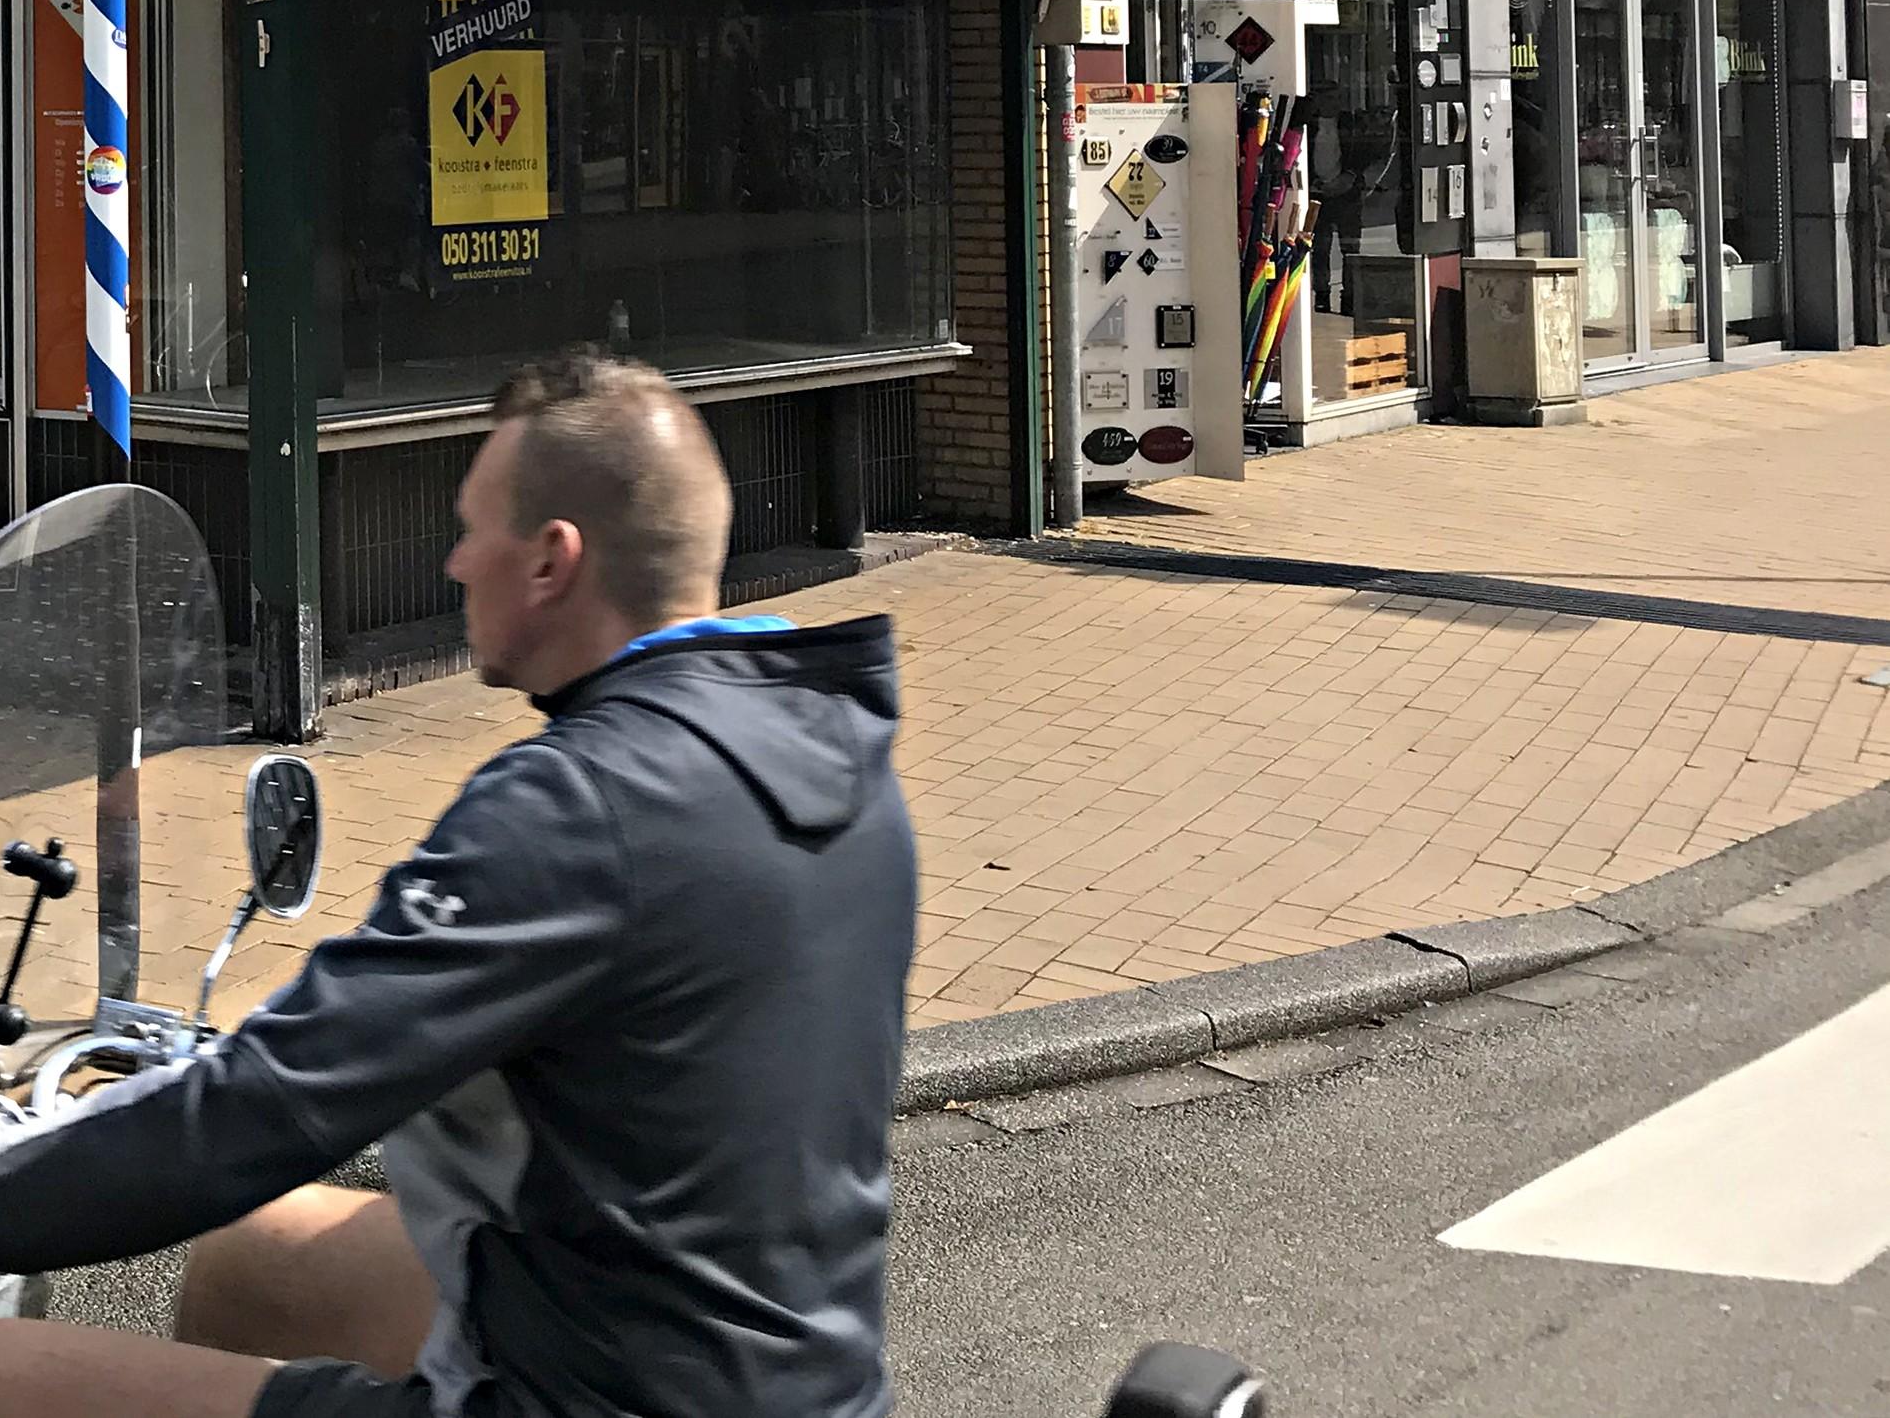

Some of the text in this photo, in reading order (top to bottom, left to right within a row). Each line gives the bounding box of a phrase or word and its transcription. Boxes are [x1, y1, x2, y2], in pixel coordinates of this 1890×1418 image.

[1512, 32, 1539, 68] ink
[1730, 38, 1766, 72] Blink
[438, 156, 538, 173] kooistra feenstra
[1090, 141, 1106, 161] 85
[442, 228, 540, 266] 050 311 30 31
[1159, 371, 1174, 385] 19
